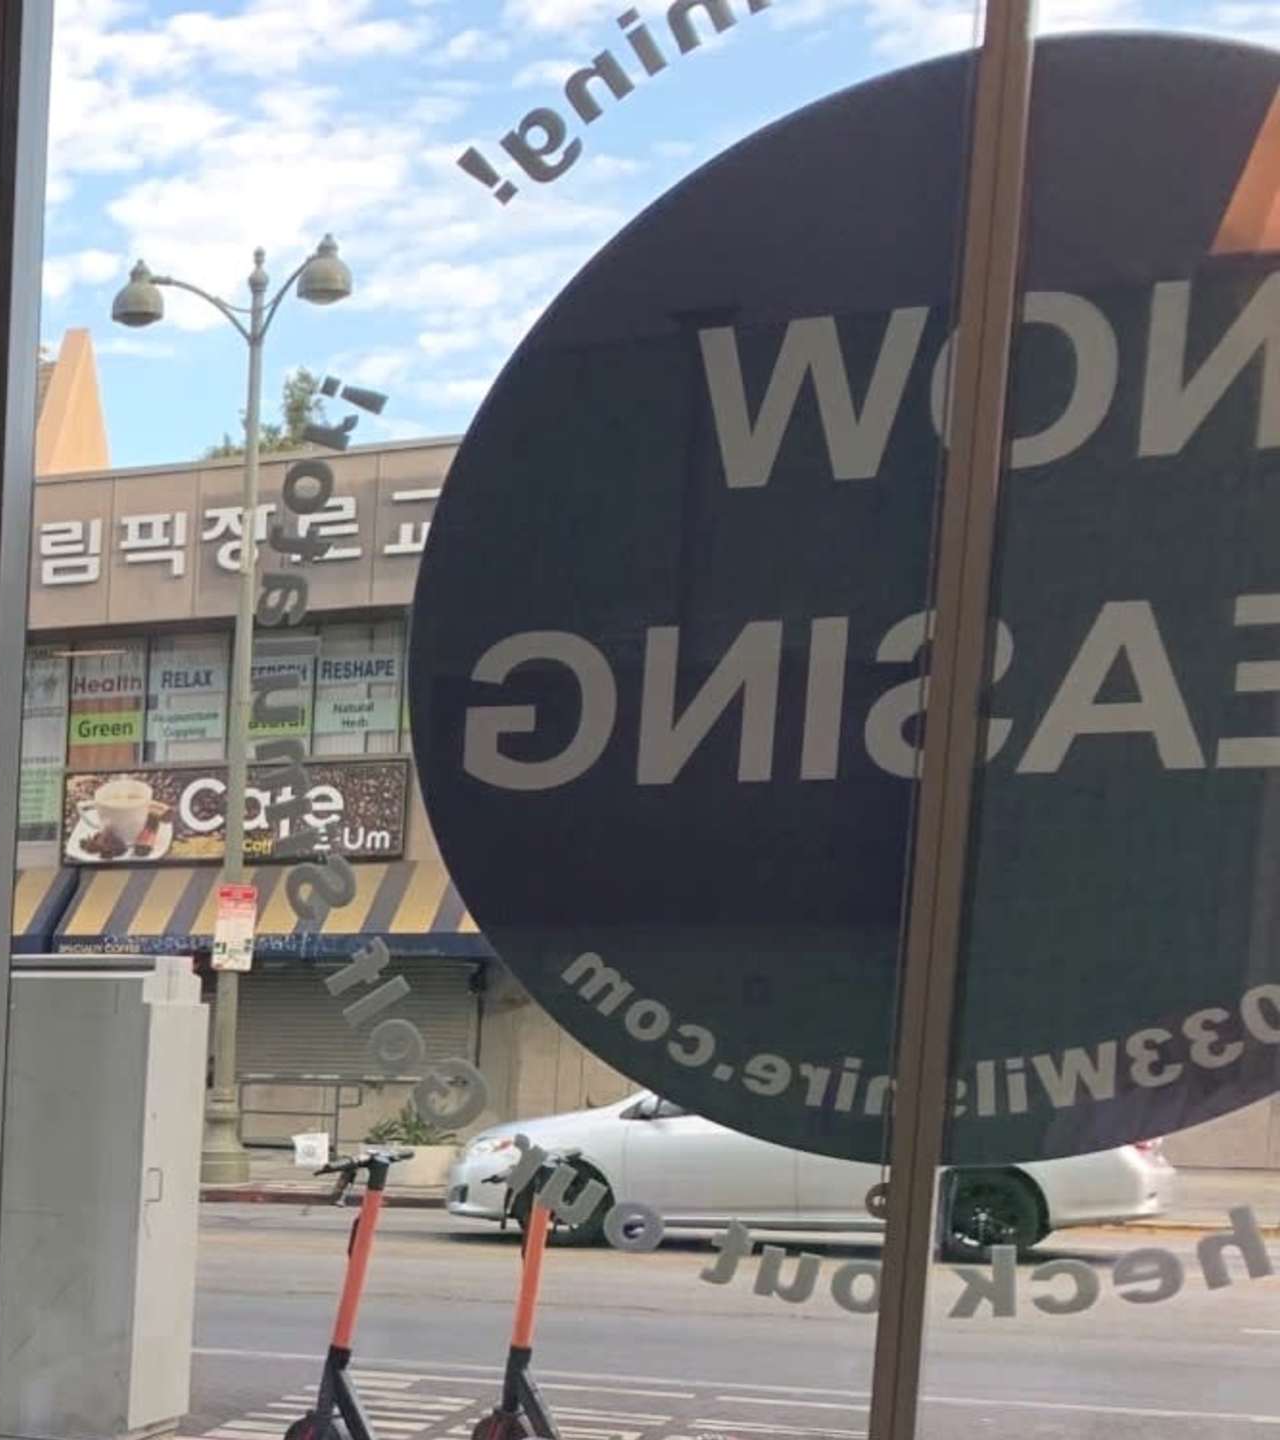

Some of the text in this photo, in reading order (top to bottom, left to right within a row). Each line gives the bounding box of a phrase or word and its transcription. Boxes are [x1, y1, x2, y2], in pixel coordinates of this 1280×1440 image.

[161, 669, 214, 688] RELAX
[321, 658, 395, 680] RESHAPE
[72, 675, 142, 694] Health
[78, 719, 134, 738] Green
